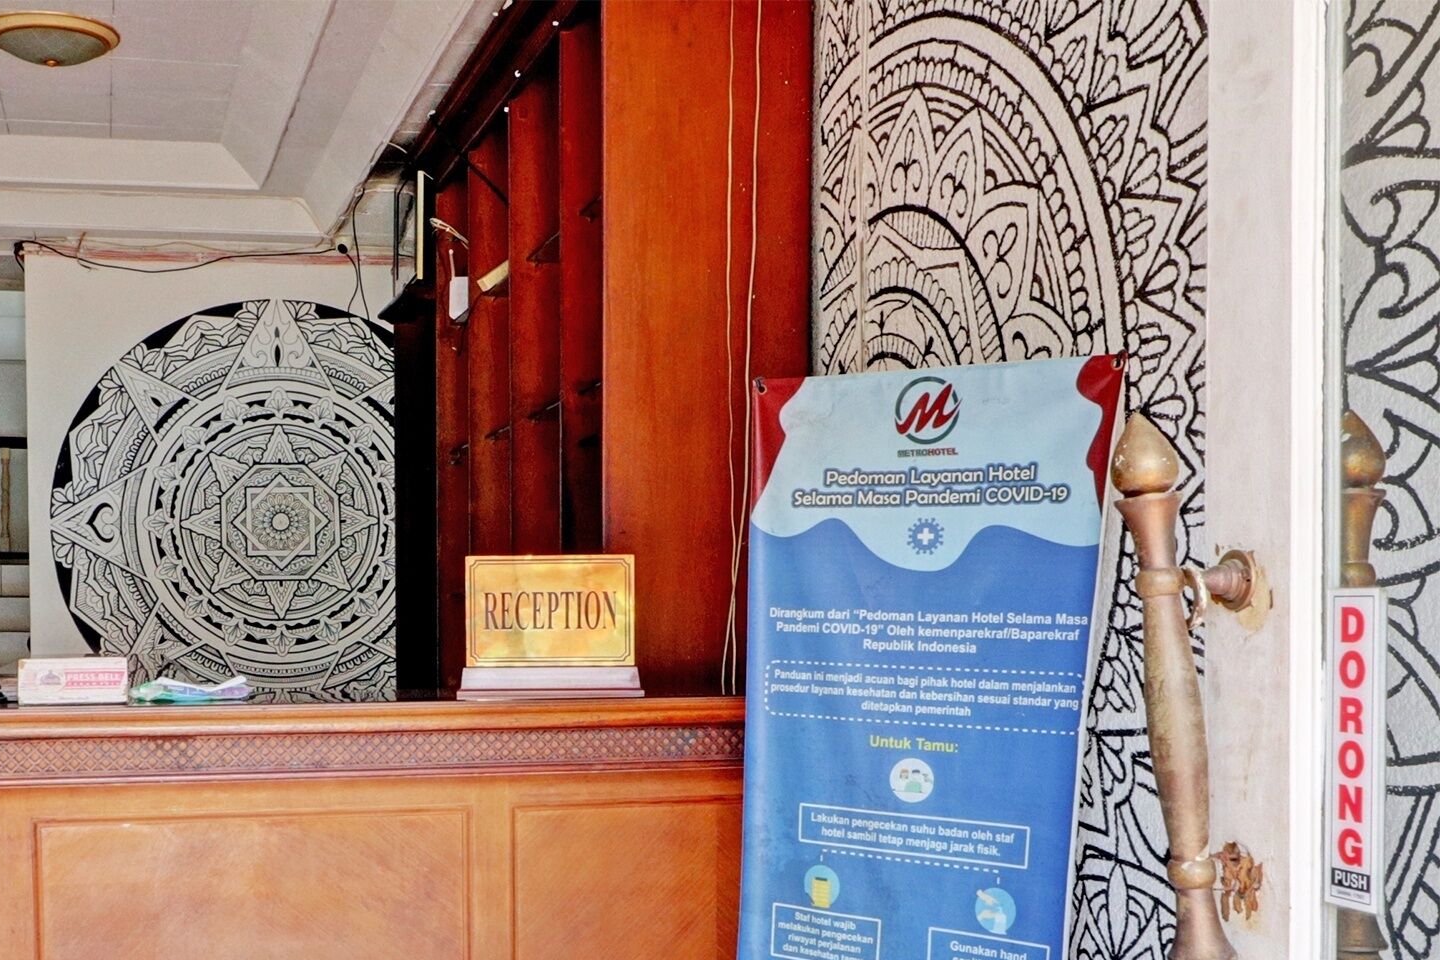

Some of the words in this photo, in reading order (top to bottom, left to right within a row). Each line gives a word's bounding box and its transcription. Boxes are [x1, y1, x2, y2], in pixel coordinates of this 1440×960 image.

[897, 447, 959, 458] METROHOTEL
[825, 468, 906, 487] Pedoman
[910, 466, 983, 488] Layanan
[988, 463, 1036, 482] Hotel
[793, 489, 853, 507] Selama
[857, 489, 900, 506] Masa
[905, 487, 980, 505] Pandemi
[985, 485, 1068, 503] COVID-19
[484, 590, 617, 631] RECEPTION
[769, 607, 824, 620] Dirangkum
[827, 609, 850, 620] dari
[917, 611, 968, 625] Layanan
[972, 612, 1003, 624] Hotel
[1007, 613, 1052, 625] Selama
[1055, 613, 1089, 625] Masa
[776, 621, 819, 634] Pandemi
[887, 624, 914, 636] Oleh
[917, 625, 1080, 642] kemenparekraf/Baparekraf
[863, 638, 914, 652] Republik
[917, 639, 977, 654] Indonesia
[66, 672, 97, 681] PRESS
[774, 669, 812, 680] Panduan
[814, 670, 824, 681] ini
[826, 671, 863, 685] menjadi
[865, 674, 894, 685] acuan
[897, 675, 918, 688] bagi
[921, 676, 948, 689] pihak
[951, 677, 976, 689] hotel
[978, 679, 1009, 690] dalam
[1012, 681, 1077, 695] menjalankan
[771, 683, 809, 694] prosedur
[811, 684, 845, 697] layanan
[847, 685, 897, 698] kesehatan
[899, 689, 917, 699] dan
[920, 689, 975, 703] kebersihan
[977, 693, 1010, 705] sesuai
[1013, 695, 1052, 707] standar
[1054, 698, 1079, 710] yang
[861, 700, 913, 713] ditetapkan
[915, 703, 971, 717] pemerintah
[869, 734, 911, 751] Untuk
[916, 736, 958, 754] Tamu:
[1337, 606, 1366, 868] DORONG
[811, 812, 849, 825] Lakukan
[851, 817, 908, 833] pengecekan
[910, 823, 936, 835] suhu
[938, 826, 968, 838] badan
[971, 829, 993, 841] oleh
[995, 832, 1015, 844] staf
[821, 826, 845, 838] hotel
[847, 829, 877, 842] sambil
[878, 833, 903, 847] tetap
[906, 837, 947, 852] menjaga
[949, 840, 974, 854] jarak
[977, 844, 1000, 857] fisik.
[1334, 869, 1367, 891] PUSH
[794, 911, 810, 922] Staf
[811, 915, 831, 926] hotel
[832, 918, 856, 931] wajib
[778, 921, 820, 935] melakukan
[821, 929, 873, 944] pengecekan
[782, 943, 798, 953] dan
[800, 945, 839, 960] kesehatan
[788, 933, 816, 946] riwayat
[818, 940, 861, 954] perjalanan
[949, 940, 998, 958] Gunakan
